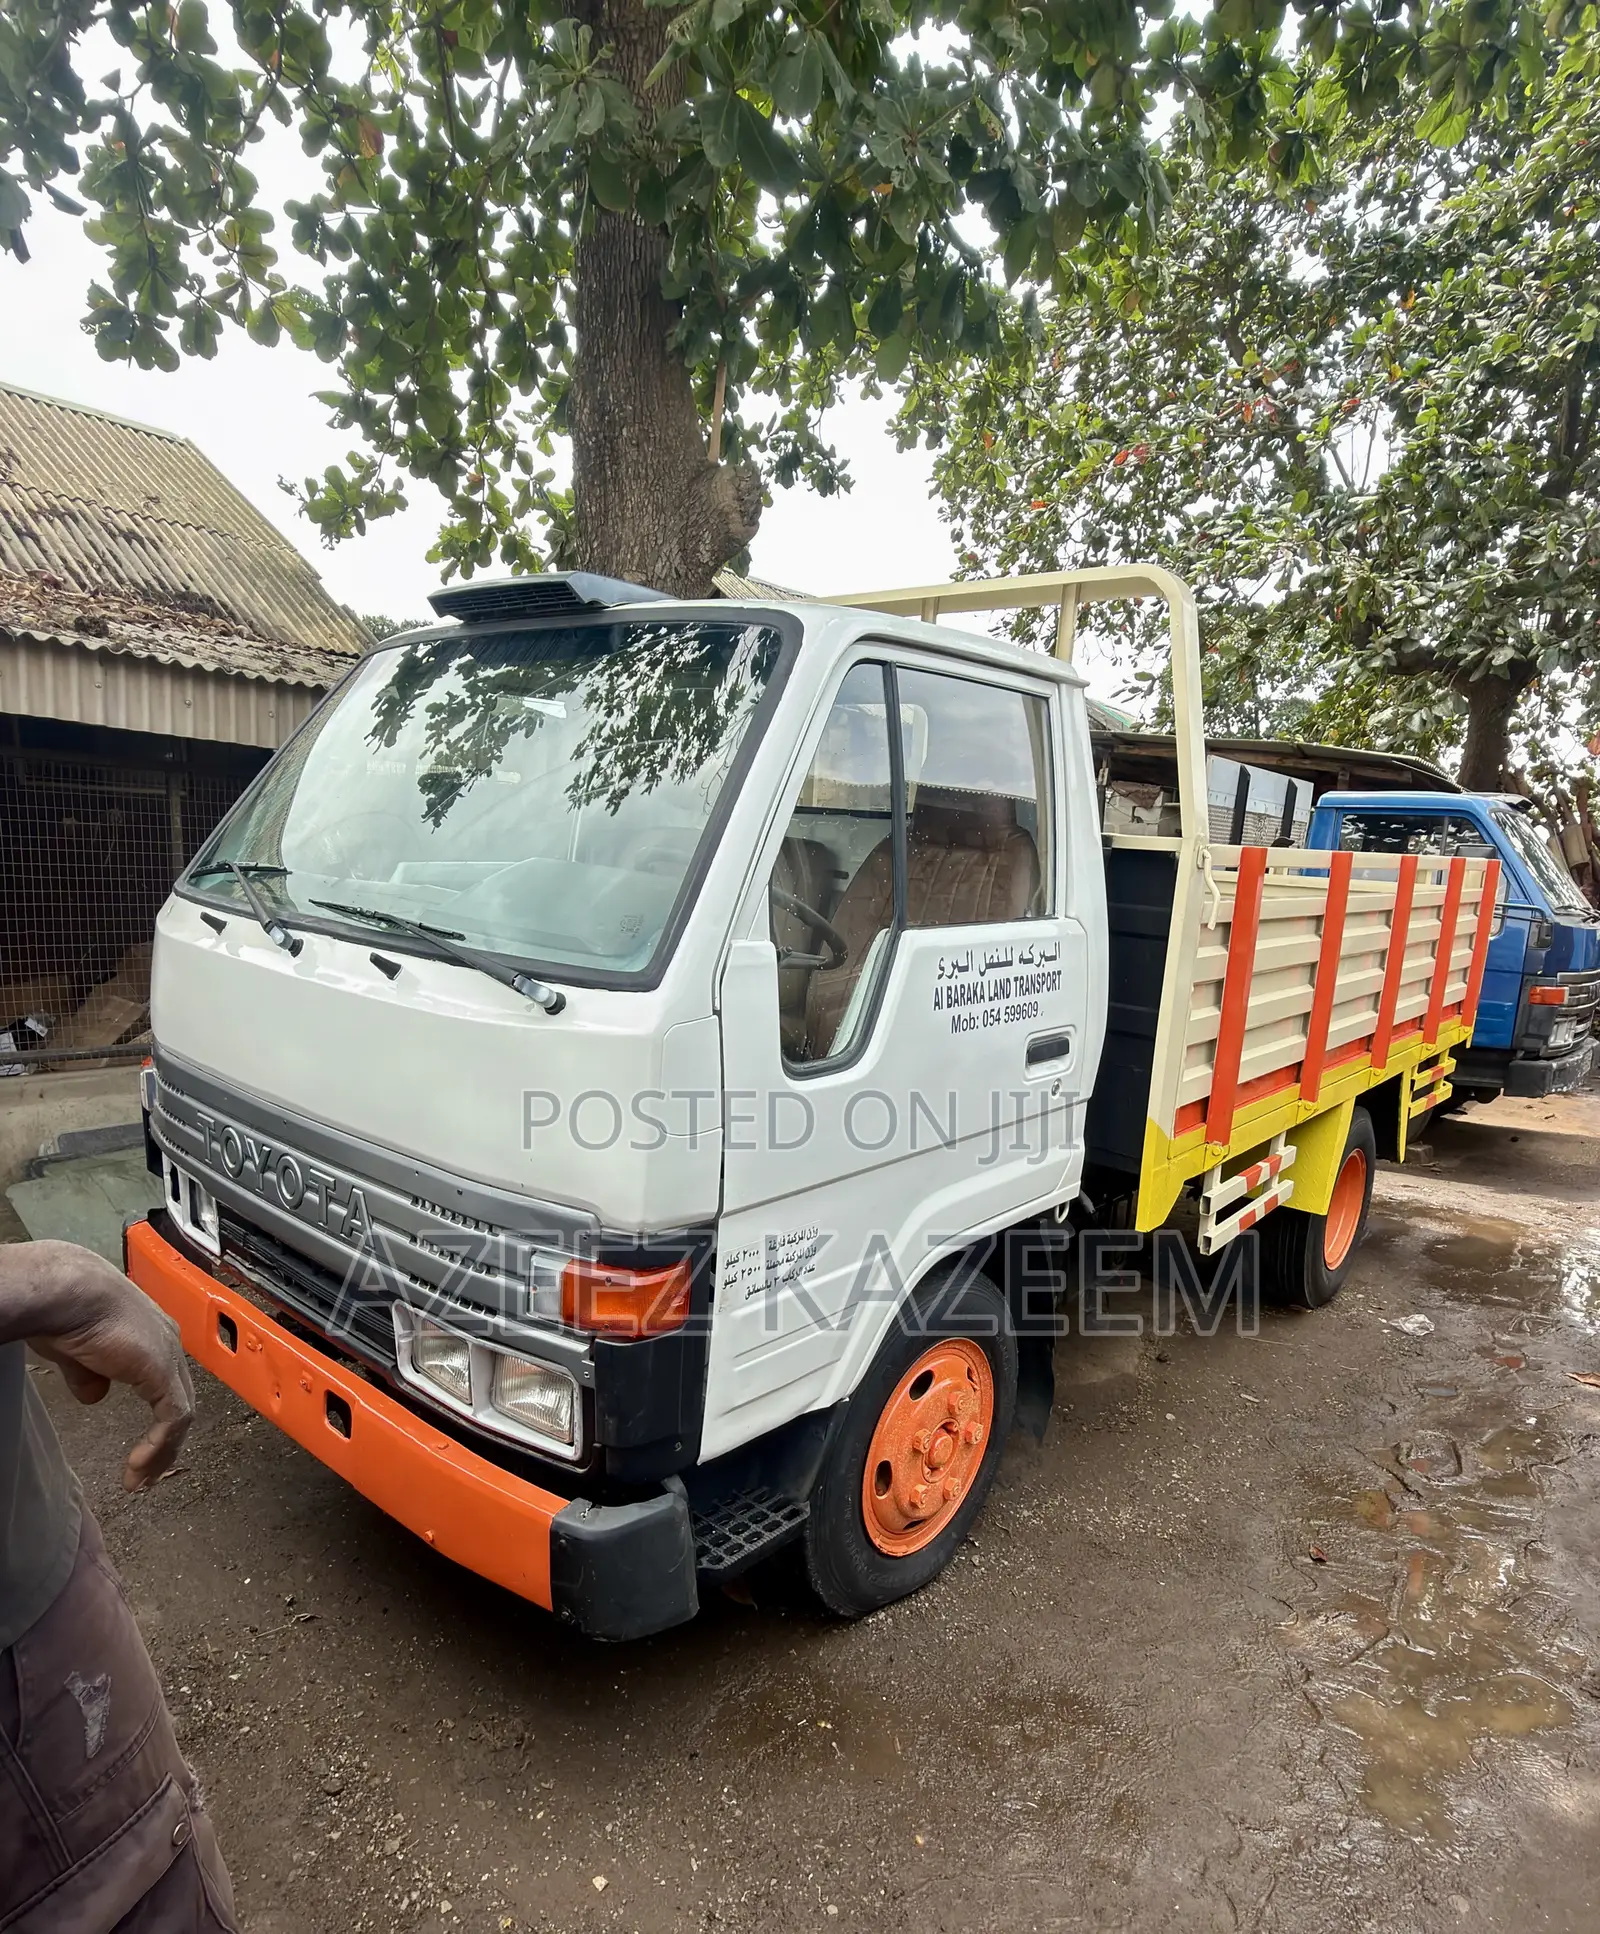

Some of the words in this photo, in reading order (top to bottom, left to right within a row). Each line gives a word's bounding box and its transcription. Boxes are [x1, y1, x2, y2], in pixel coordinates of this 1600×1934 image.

[946, 980, 986, 1009] BARAKA
[988, 977, 1012, 1001] LAND
[1013, 970, 1062, 998] TRANSPORT
[951, 1010, 979, 1034] Mob:
[982, 1007, 1001, 1028] 054
[1004, 1001, 1039, 1024] 599609
[197, 1111, 376, 1251] TOYOTA
